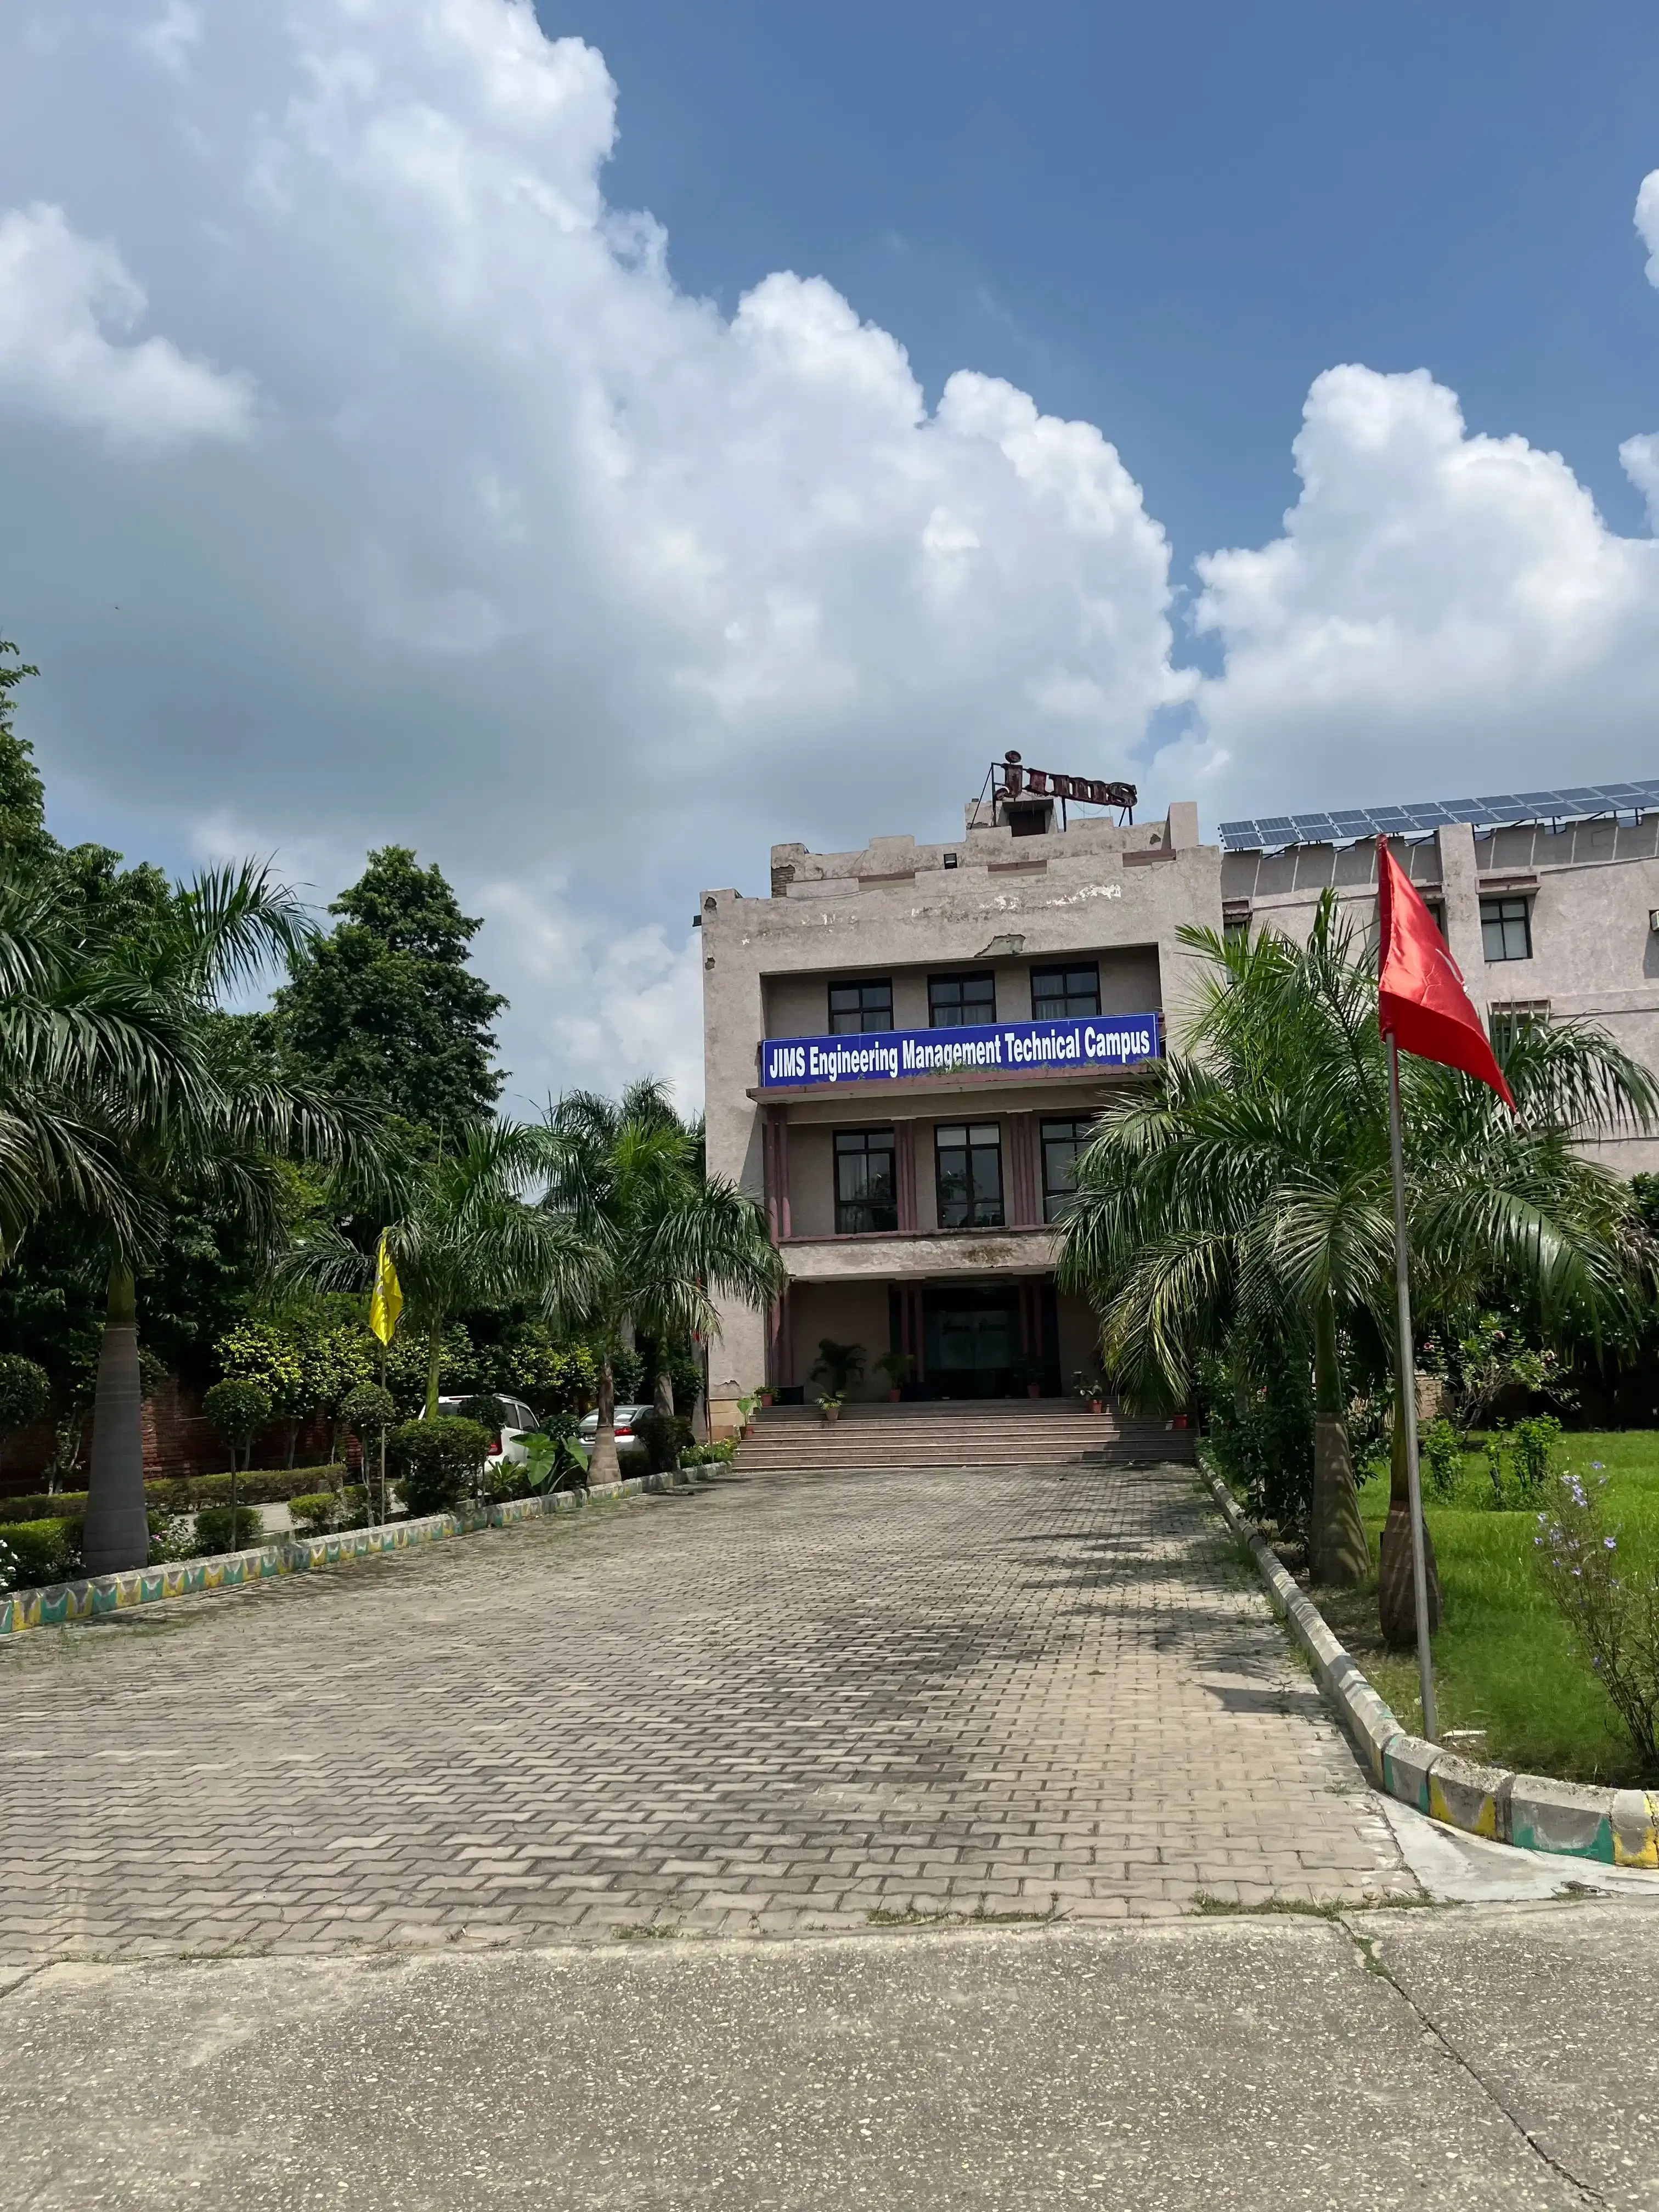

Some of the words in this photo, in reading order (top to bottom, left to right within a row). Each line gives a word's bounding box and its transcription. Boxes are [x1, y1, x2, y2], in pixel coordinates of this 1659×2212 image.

[770, 1047, 805, 1079] JIMS
[810, 1041, 898, 1082] Engineering
[902, 1035, 1002, 1073] Management
[1005, 1028, 1080, 1062] Technical
[1085, 1026, 1150, 1063] Campus
